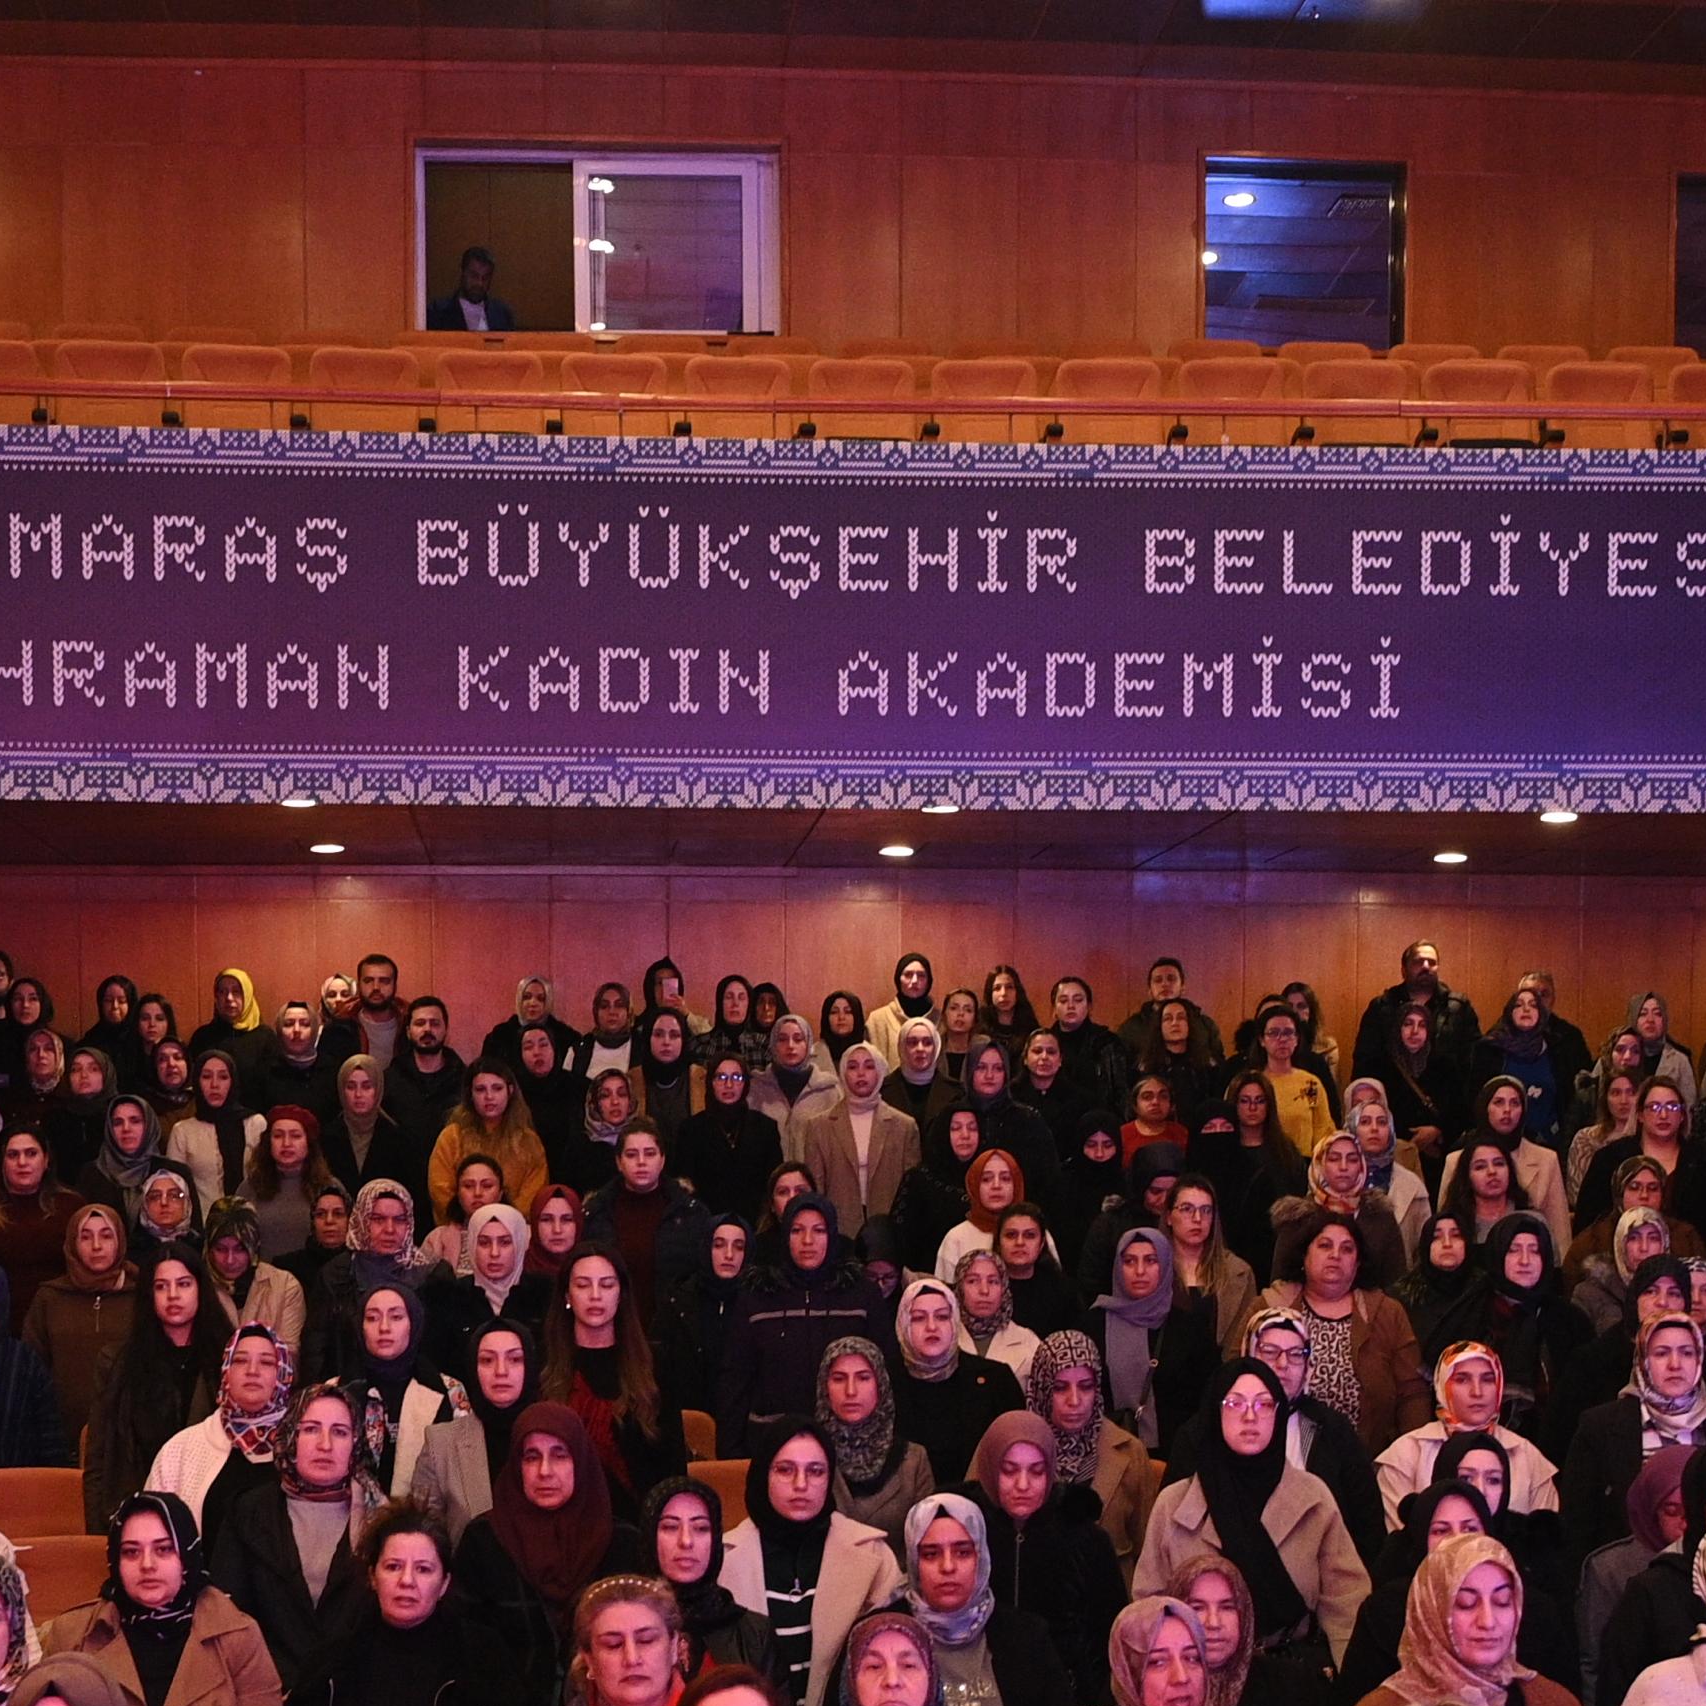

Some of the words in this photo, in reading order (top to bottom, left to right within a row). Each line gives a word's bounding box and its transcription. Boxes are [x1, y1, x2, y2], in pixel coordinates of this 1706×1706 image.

[418, 504, 1077, 600] BÜYÜKŞEHİR
[459, 646, 770, 715] KADIN
[839, 636, 1401, 719] AKADEMİSİ
